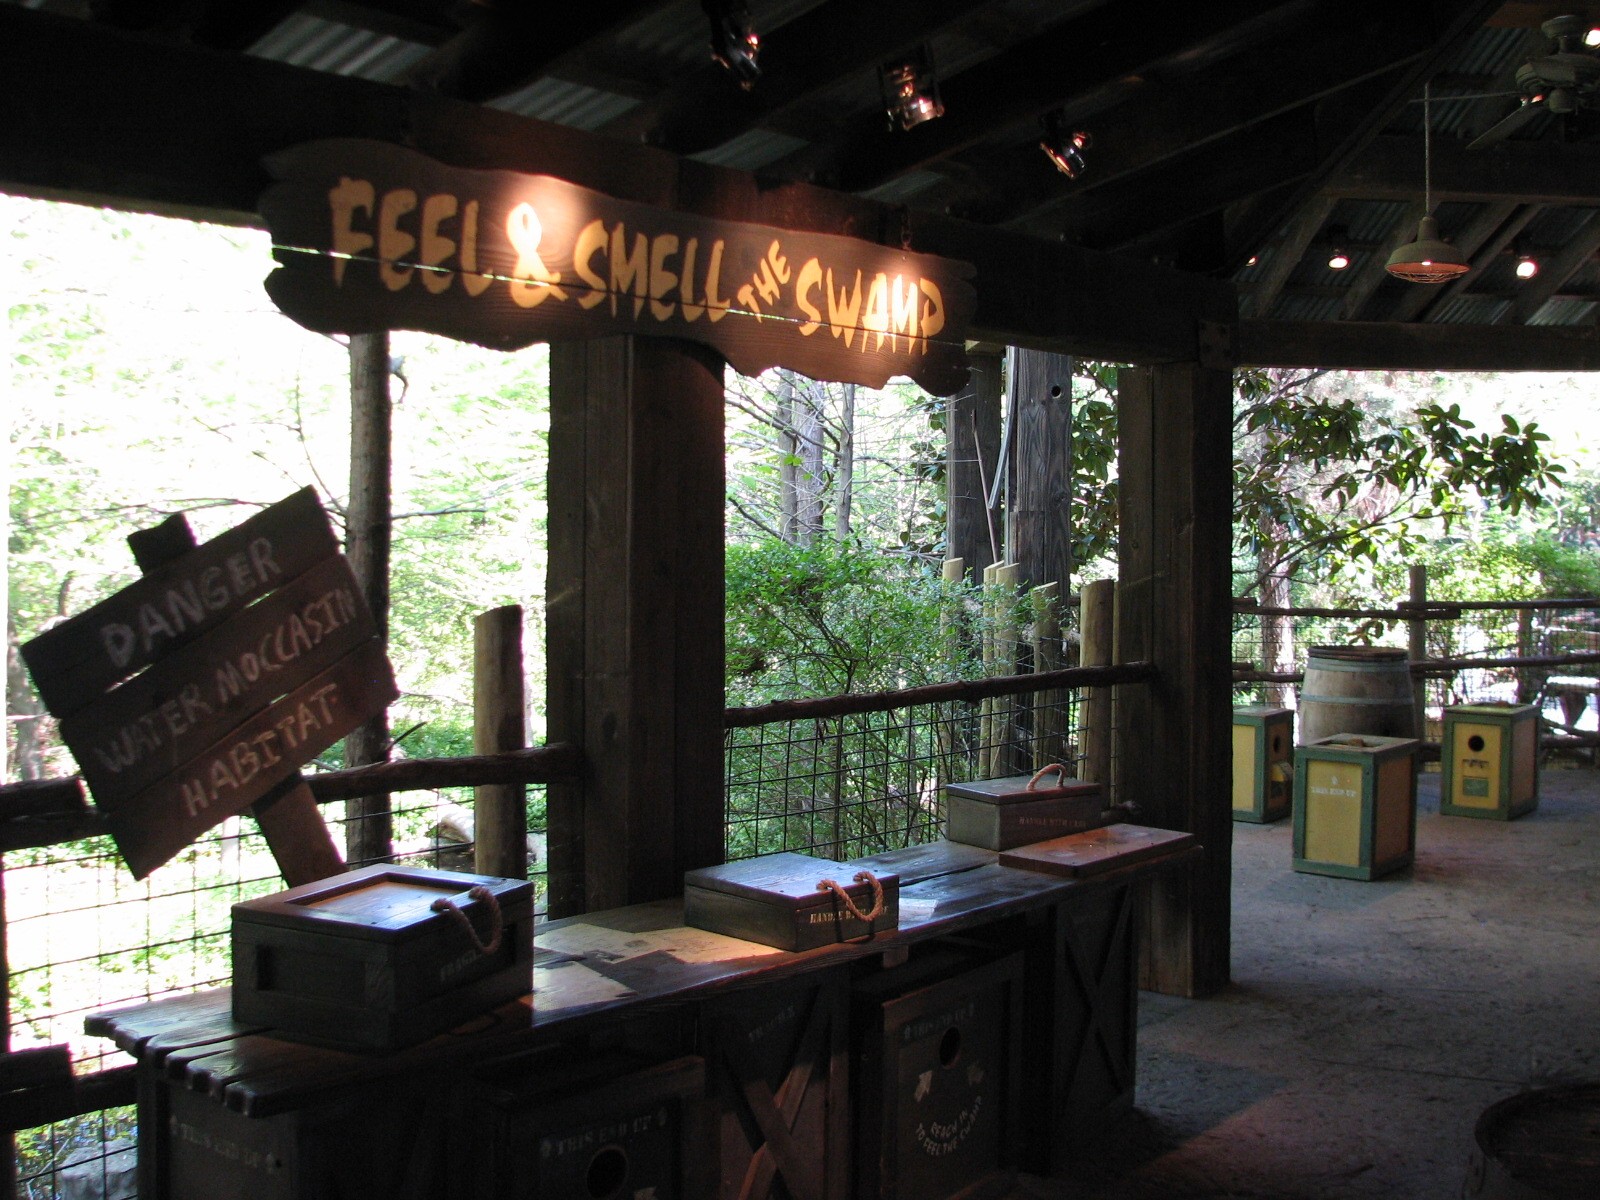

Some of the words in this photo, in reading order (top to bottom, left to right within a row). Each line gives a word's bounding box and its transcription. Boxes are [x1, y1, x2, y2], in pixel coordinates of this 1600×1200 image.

[328, 176, 494, 298] FEEL
[505, 202, 569, 309] &
[573, 219, 731, 323] SMELL
[737, 239, 792, 323] THE
[796, 257, 946, 355] SWAMP
[95, 683, 213, 774] WATER
[214, 588, 357, 705] MOCCASIN
[100, 537, 282, 668] DANGER
[181, 682, 337, 818] HABITAT
